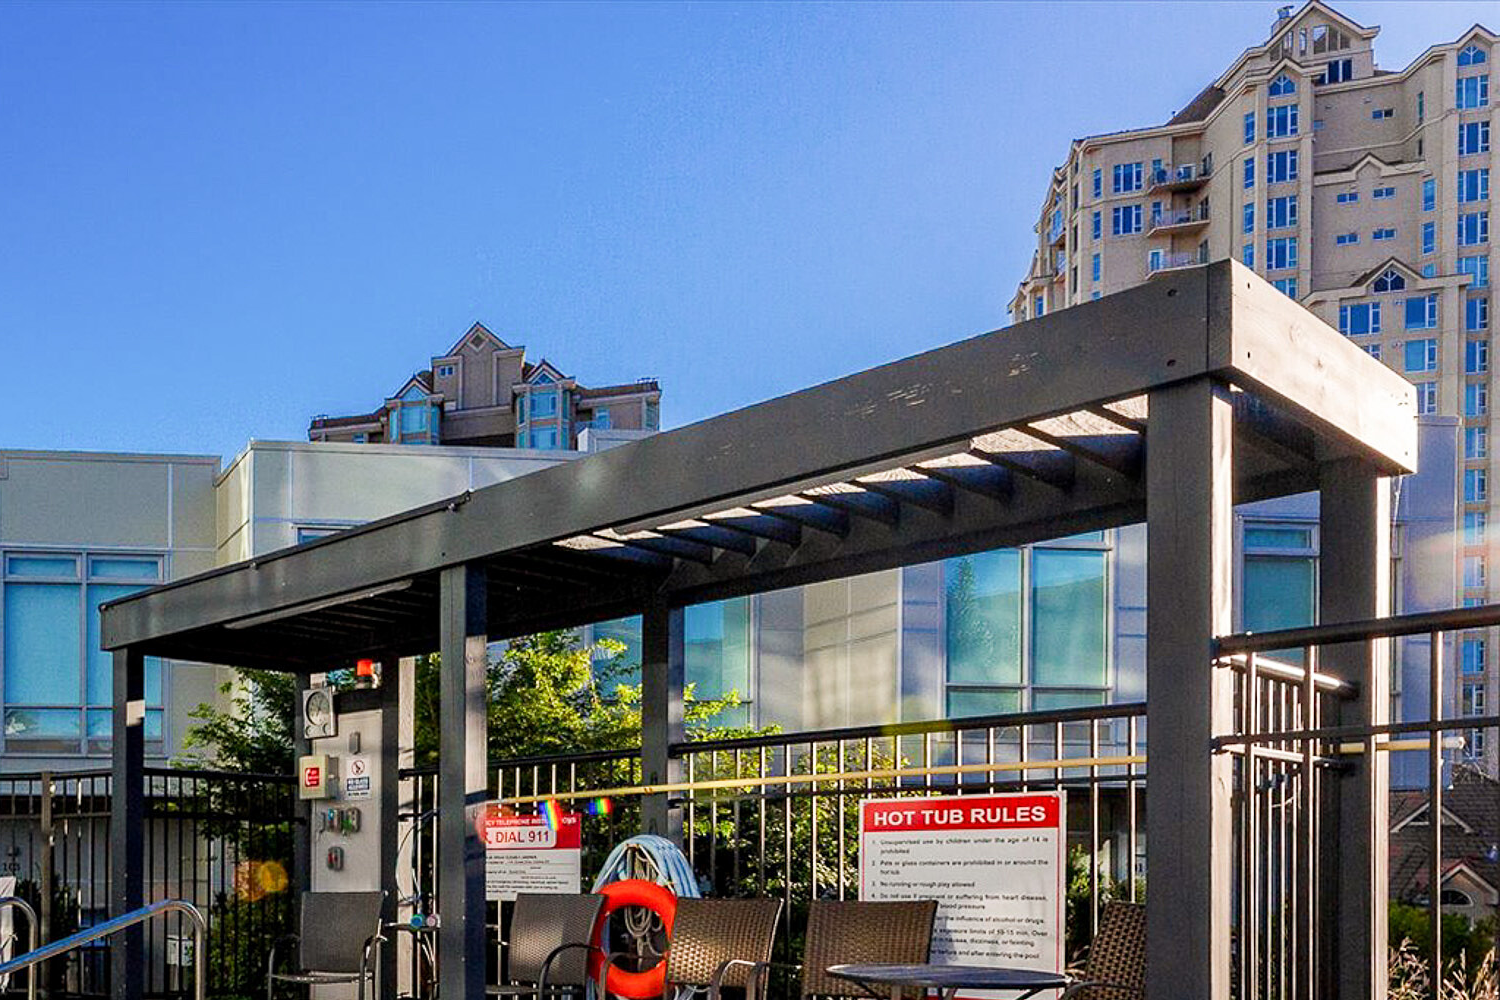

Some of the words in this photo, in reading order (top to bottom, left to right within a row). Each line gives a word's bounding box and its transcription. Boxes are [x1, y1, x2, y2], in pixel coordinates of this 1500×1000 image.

[873, 810, 916, 826] HOT
[921, 809, 963, 825] TUB
[970, 806, 1046, 823] RULES
[496, 831, 525, 843] DIAL
[528, 830, 550, 842] 911
